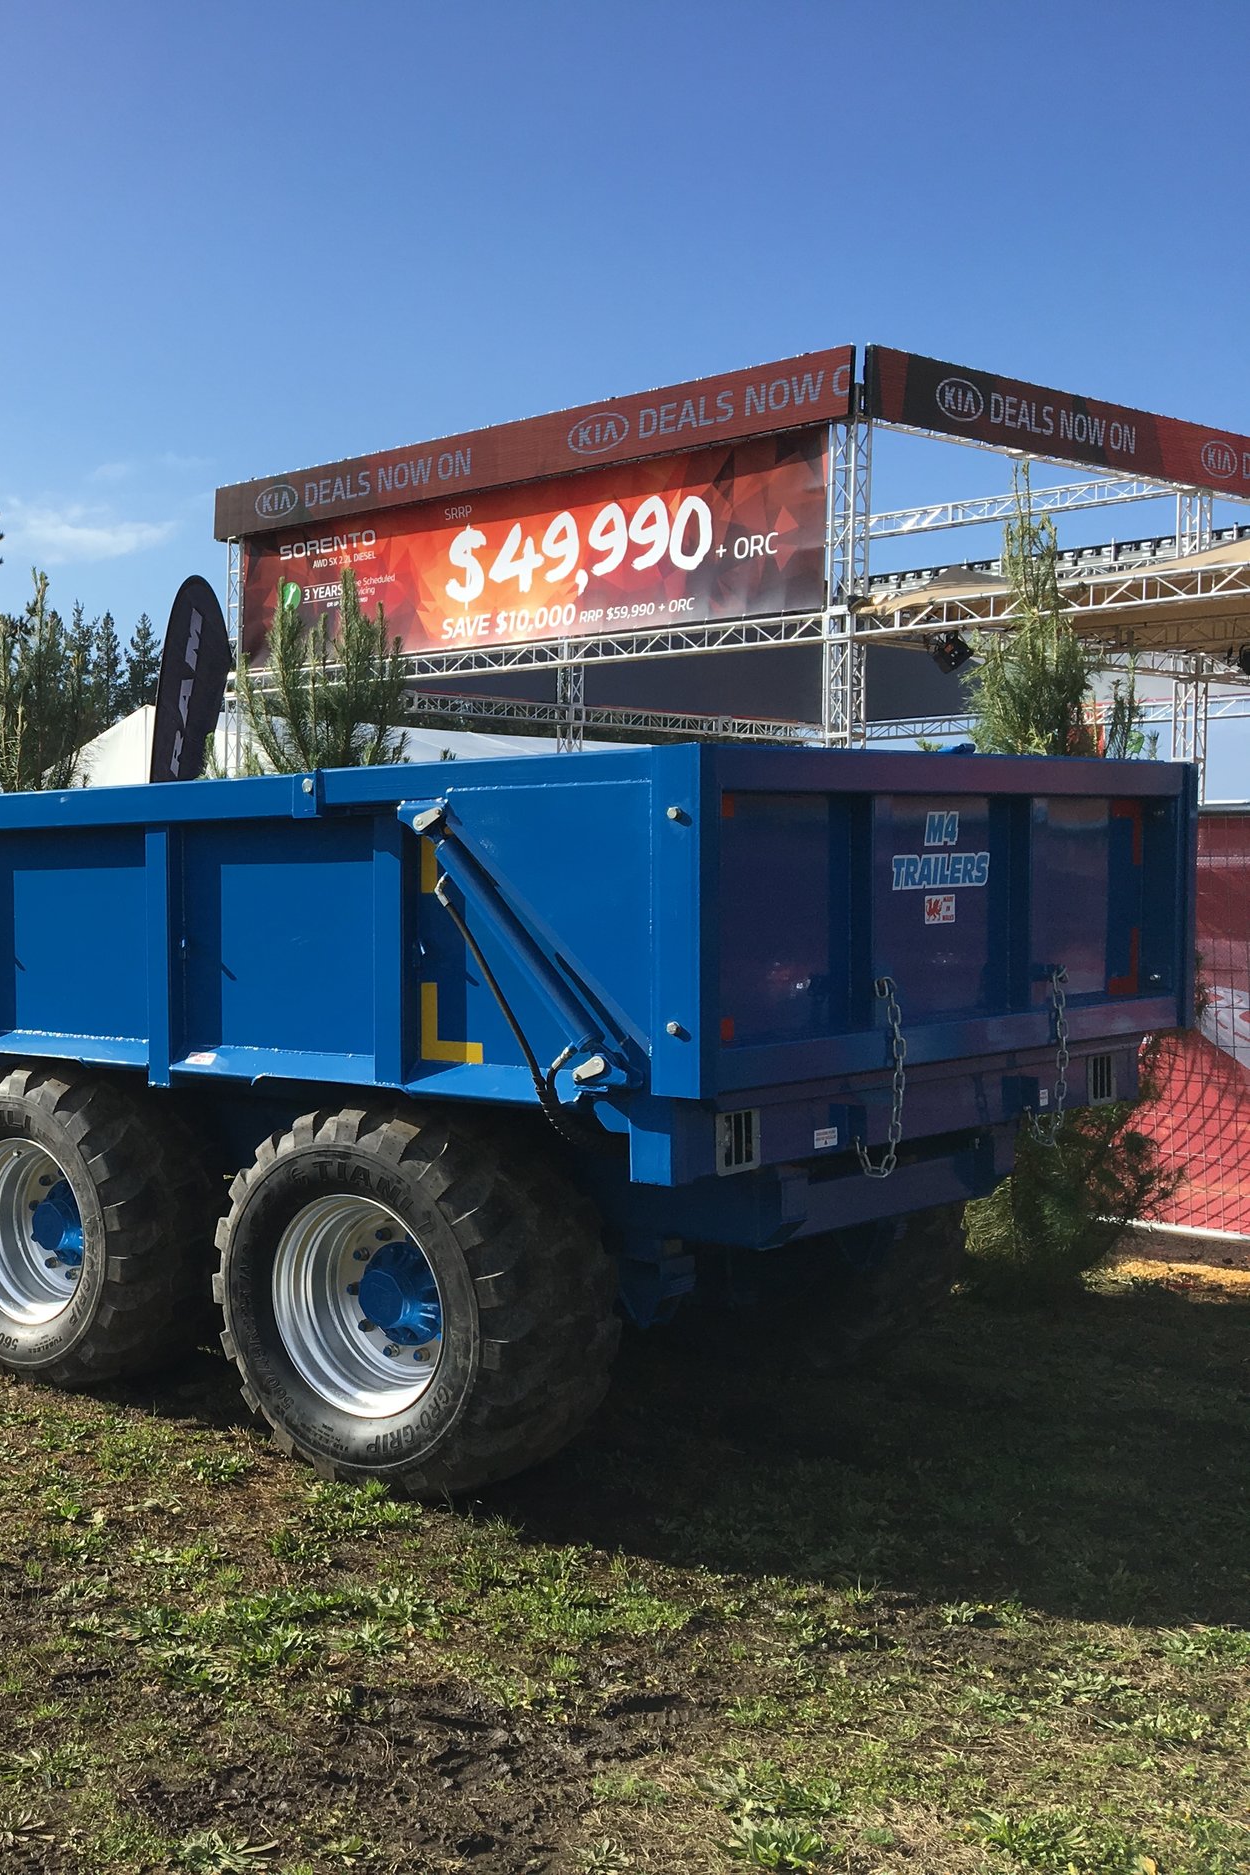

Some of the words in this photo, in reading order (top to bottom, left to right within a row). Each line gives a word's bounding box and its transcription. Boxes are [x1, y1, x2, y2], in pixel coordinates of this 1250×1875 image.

[578, 420, 618, 447] KIA
[639, 390, 734, 440] DEALS
[745, 370, 825, 417] NOW
[944, 384, 976, 414] KIA
[990, 392, 1054, 436] DEALS
[1059, 409, 1106, 447] NOW
[1110, 421, 1136, 454] ON
[261, 490, 291, 514] KIA
[304, 471, 371, 509] DEALS
[377, 456, 433, 494] NOW
[437, 448, 472, 481] ON
[1207, 452, 1231, 472] KIA
[444, 504, 472, 521] SRRP
[279, 529, 376, 561] SORENTO
[312, 560, 328, 569] AWD
[329, 557, 338, 566] SX
[354, 551, 377, 562] DIESEL
[445, 495, 713, 611] $49,990
[715, 544, 727, 558] +
[733, 532, 779, 560] ORC
[304, 588, 310, 601] 3
[312, 585, 344, 599] YEARS
[441, 613, 492, 640] SAVE
[495, 604, 576, 634] $10,000
[579, 608, 604, 624] RRP
[606, 602, 655, 621] $59,990
[668, 597, 695, 613] ORC
[169, 607, 203, 778] RAM
[924, 811, 959, 846] M4
[892, 852, 990, 890] TRAILERS
